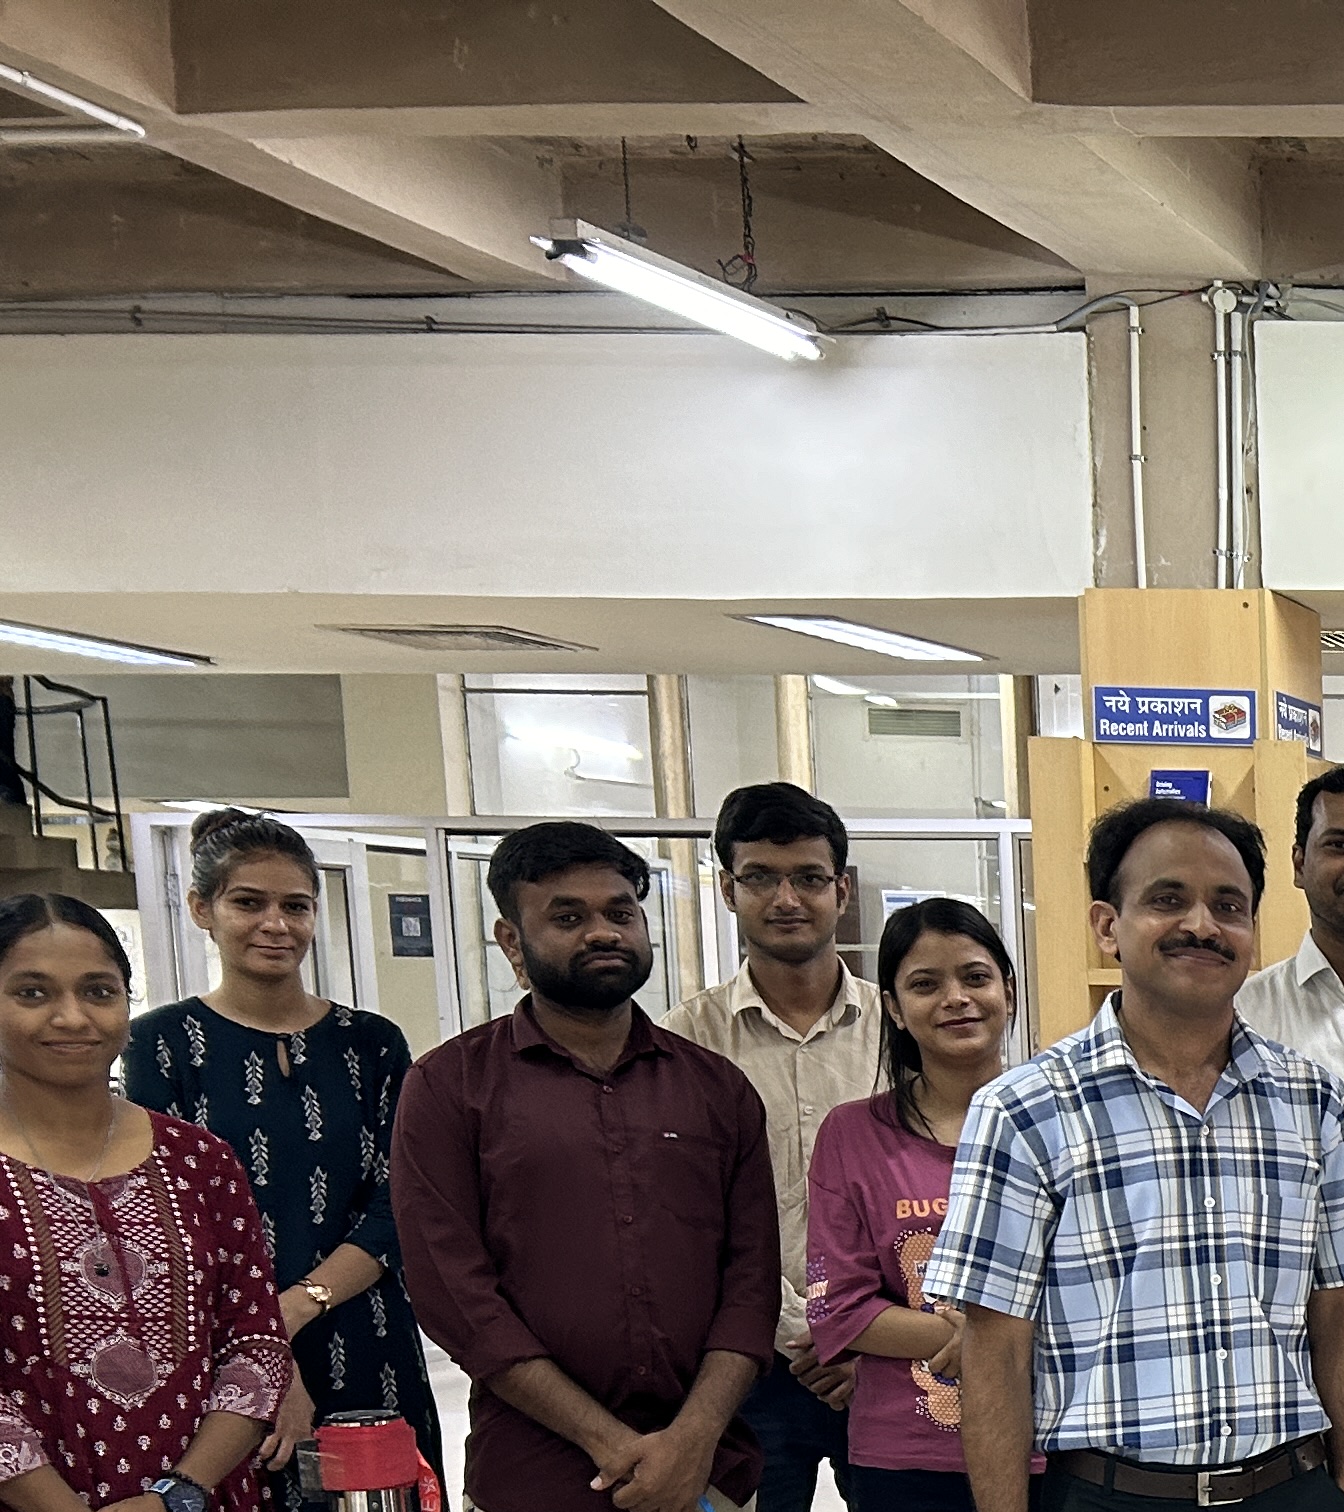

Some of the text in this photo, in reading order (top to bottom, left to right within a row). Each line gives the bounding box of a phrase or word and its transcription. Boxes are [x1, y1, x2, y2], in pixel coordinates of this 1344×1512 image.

[1103, 689, 1204, 717] नये प्रकाशन
[1100, 719, 1207, 738] Recent Arrivals
[896, 1198, 949, 1219] BUG
